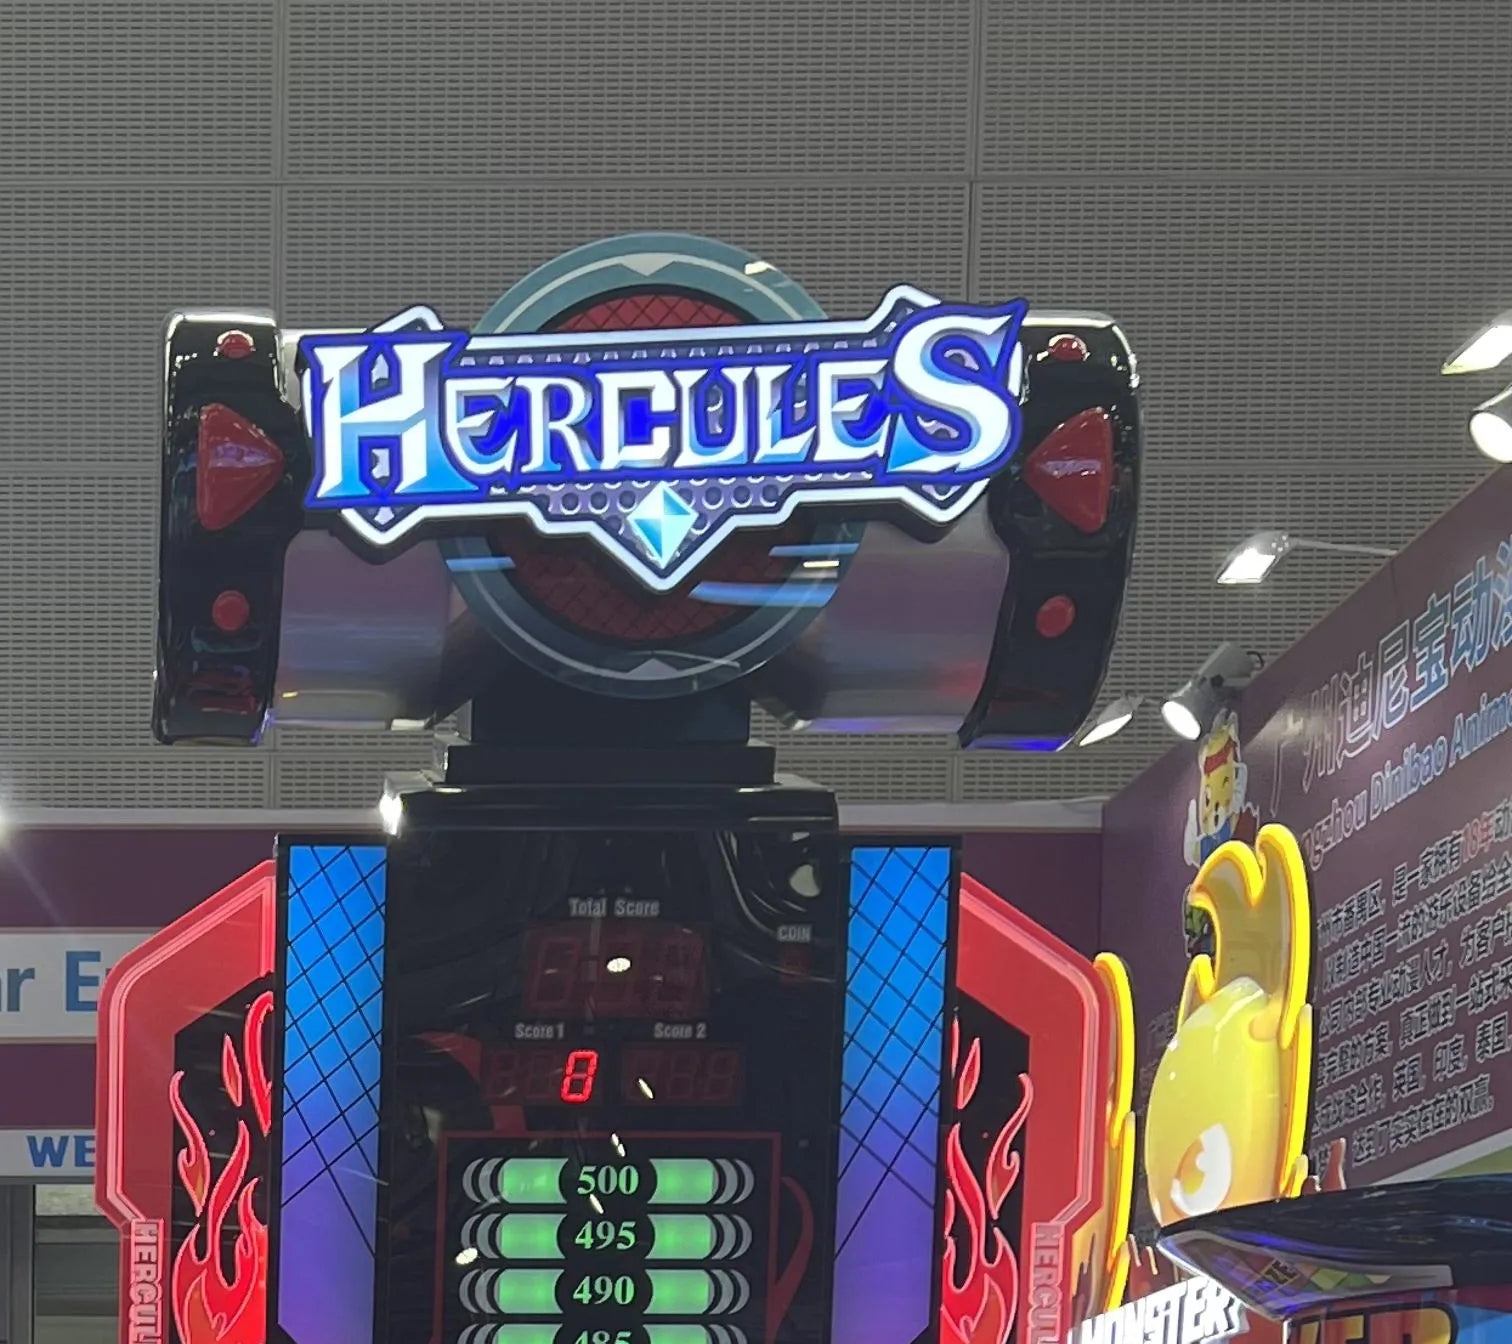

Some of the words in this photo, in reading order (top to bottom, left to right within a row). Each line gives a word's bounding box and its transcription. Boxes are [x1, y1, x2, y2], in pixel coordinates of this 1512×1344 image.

[303, 305, 1020, 507] HERCULES
[1369, 735, 1448, 822] Dinibao
[569, 898, 606, 917] Total
[615, 899, 660, 918] Score
[777, 926, 812, 942] COIN
[65, 950, 112, 1013] E
[515, 1022, 554, 1040] Score
[555, 1023, 565, 1040] 1
[653, 1022, 693, 1040] Score
[695, 1023, 708, 1040] 2
[577, 1165, 639, 1195] 500
[575, 1221, 636, 1250] 495
[572, 1275, 635, 1305] 490
